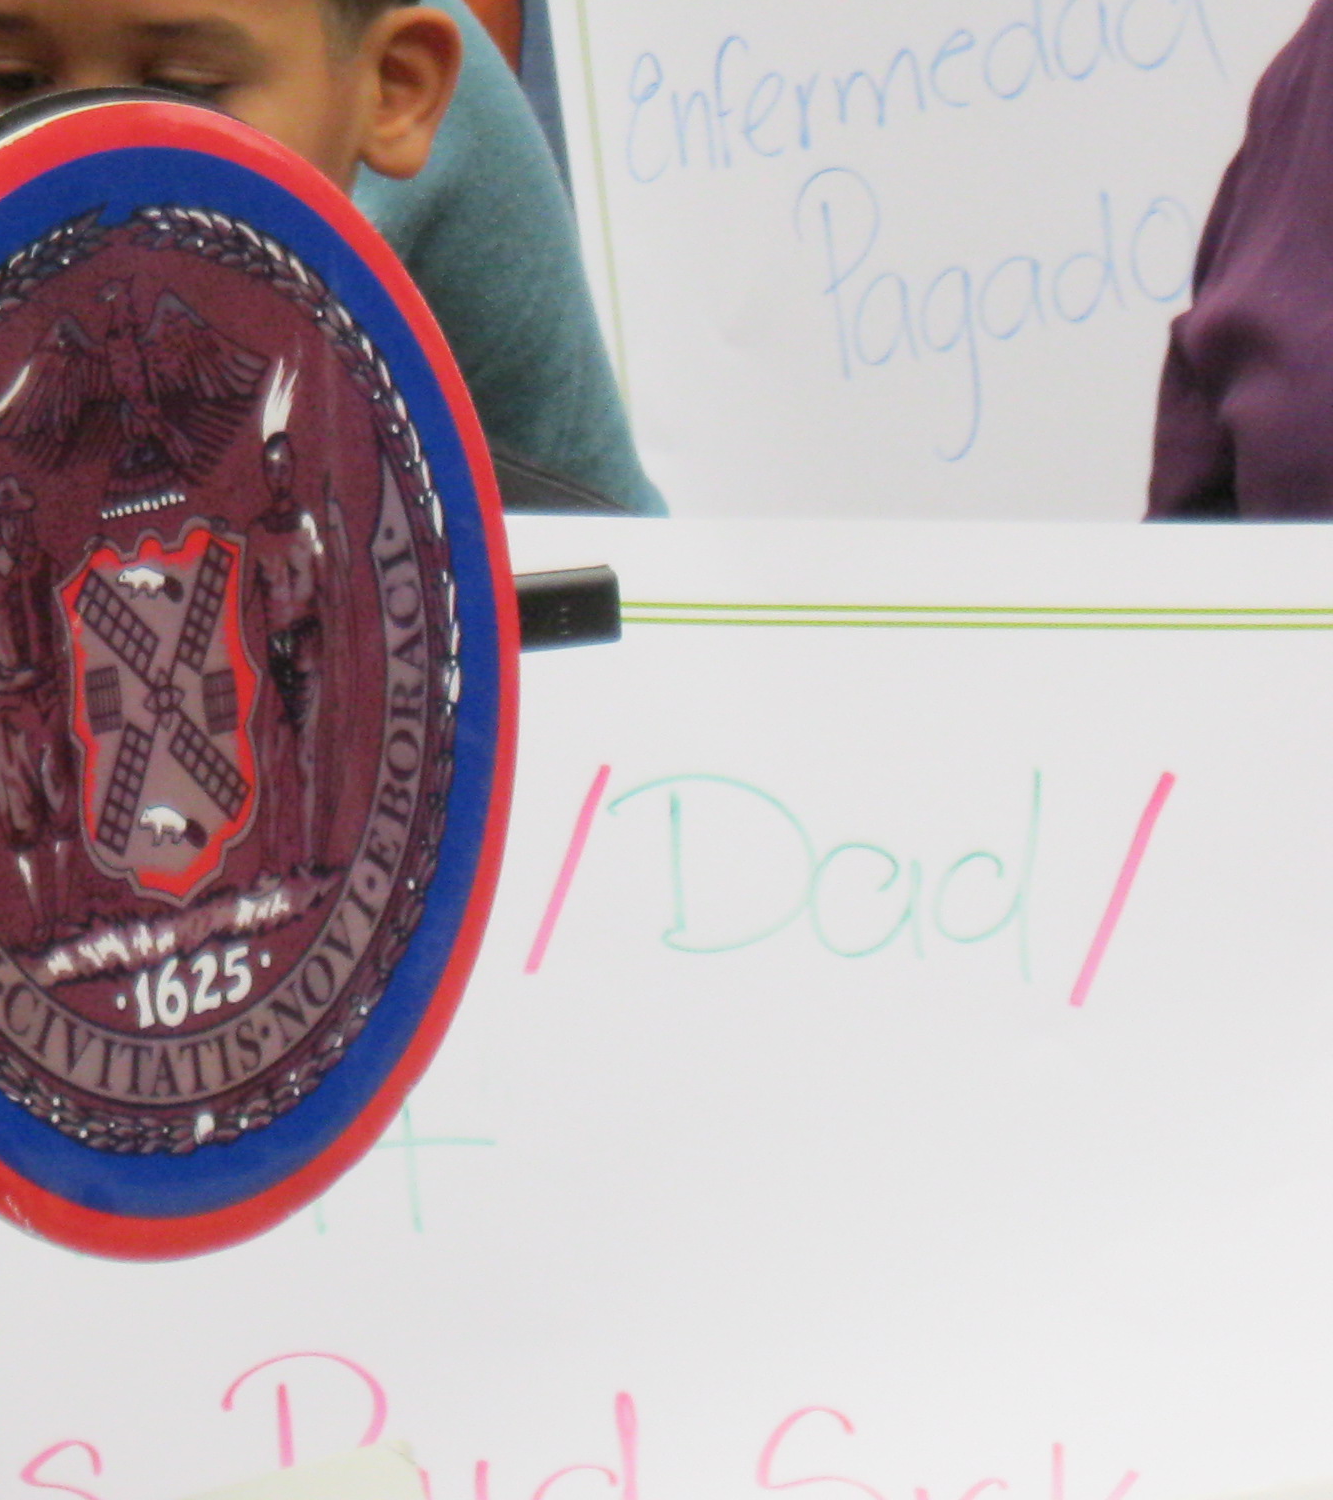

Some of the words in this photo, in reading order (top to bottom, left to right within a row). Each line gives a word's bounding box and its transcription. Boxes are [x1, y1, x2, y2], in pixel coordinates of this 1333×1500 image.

[4, 983, 264, 1097] CIVITATIS
[270, 888, 384, 1044] NOVI
[365, 544, 426, 878] EBORACI
[135, 945, 254, 1029] 1625
